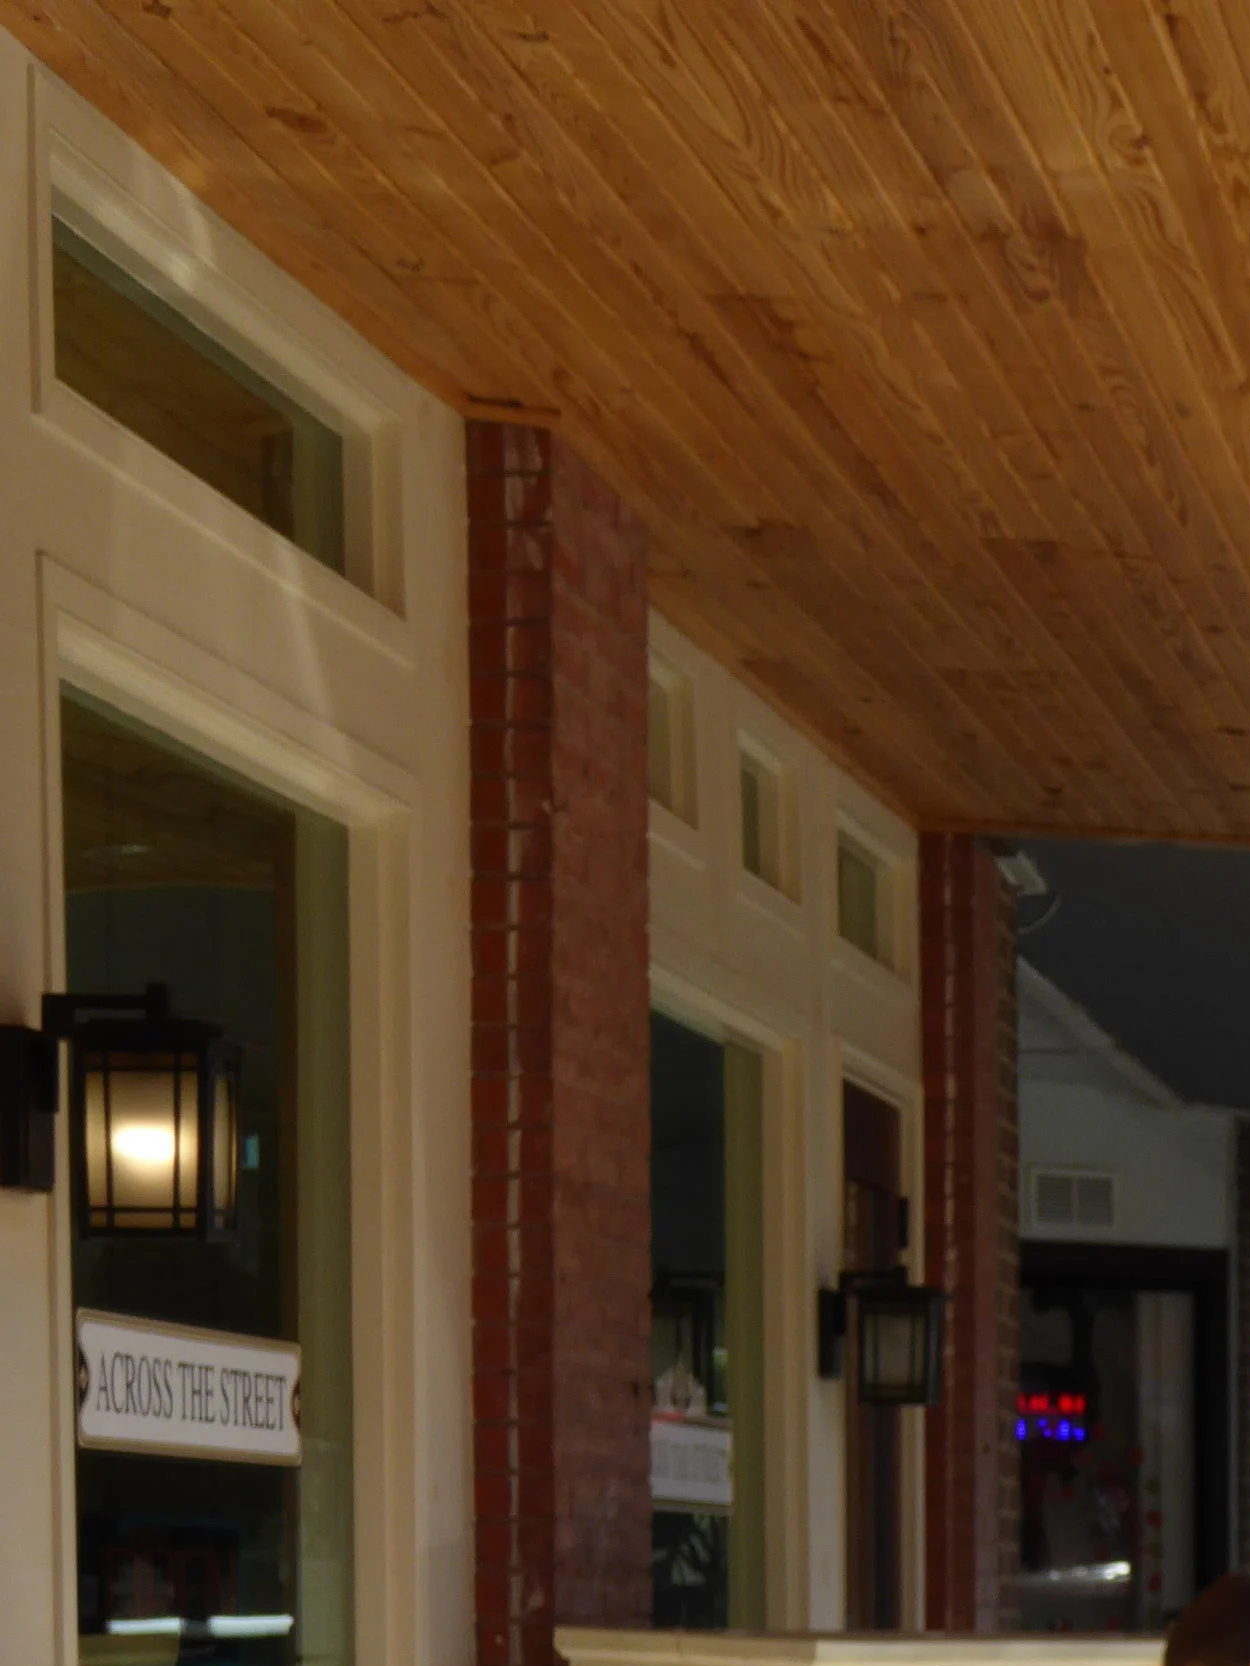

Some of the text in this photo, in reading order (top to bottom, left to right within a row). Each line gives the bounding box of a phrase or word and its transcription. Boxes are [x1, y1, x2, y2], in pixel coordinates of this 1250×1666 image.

[96, 1351, 286, 1431] ACROSS THE STREET
